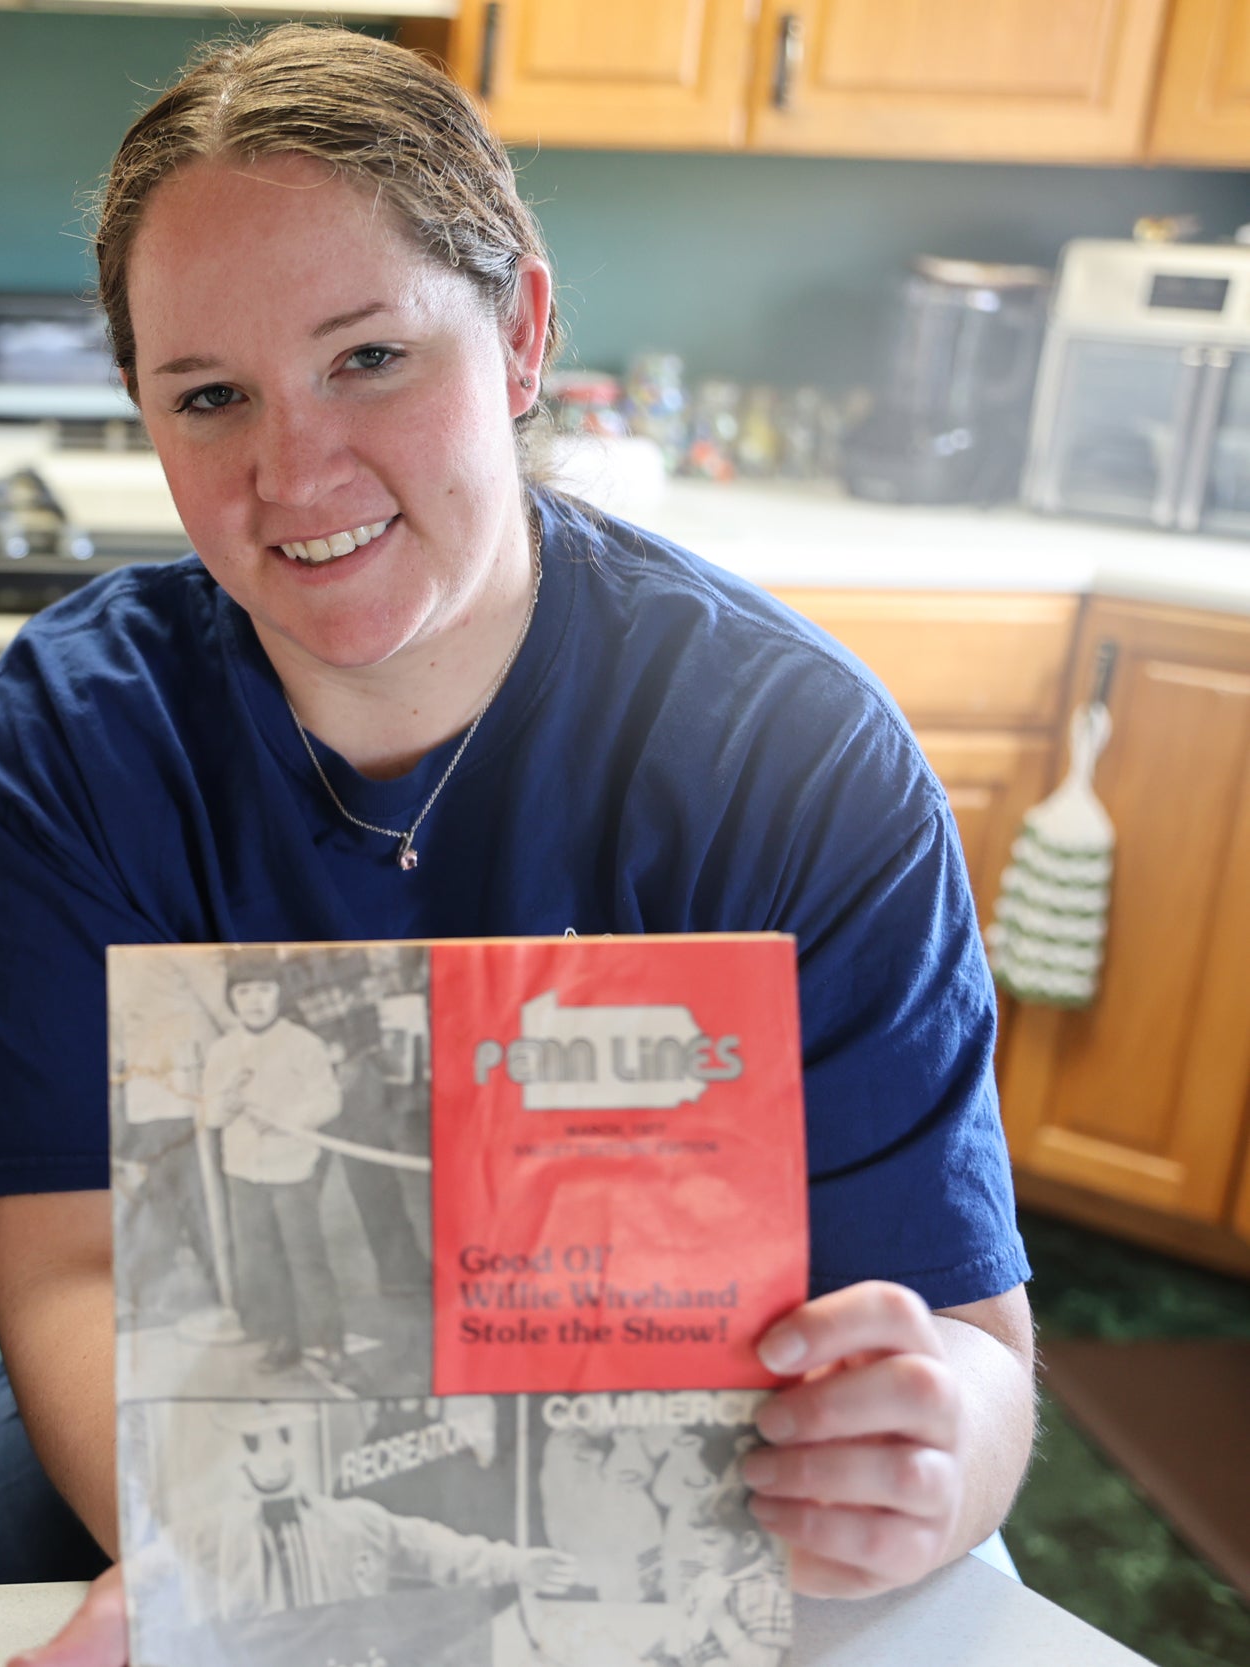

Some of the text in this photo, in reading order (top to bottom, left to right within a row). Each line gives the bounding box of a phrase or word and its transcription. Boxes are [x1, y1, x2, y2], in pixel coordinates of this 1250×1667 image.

[459, 1245, 552, 1275] Good
[459, 1280, 739, 1310] Willie Wirehand
[460, 1316, 729, 1344] Stole the Show!
